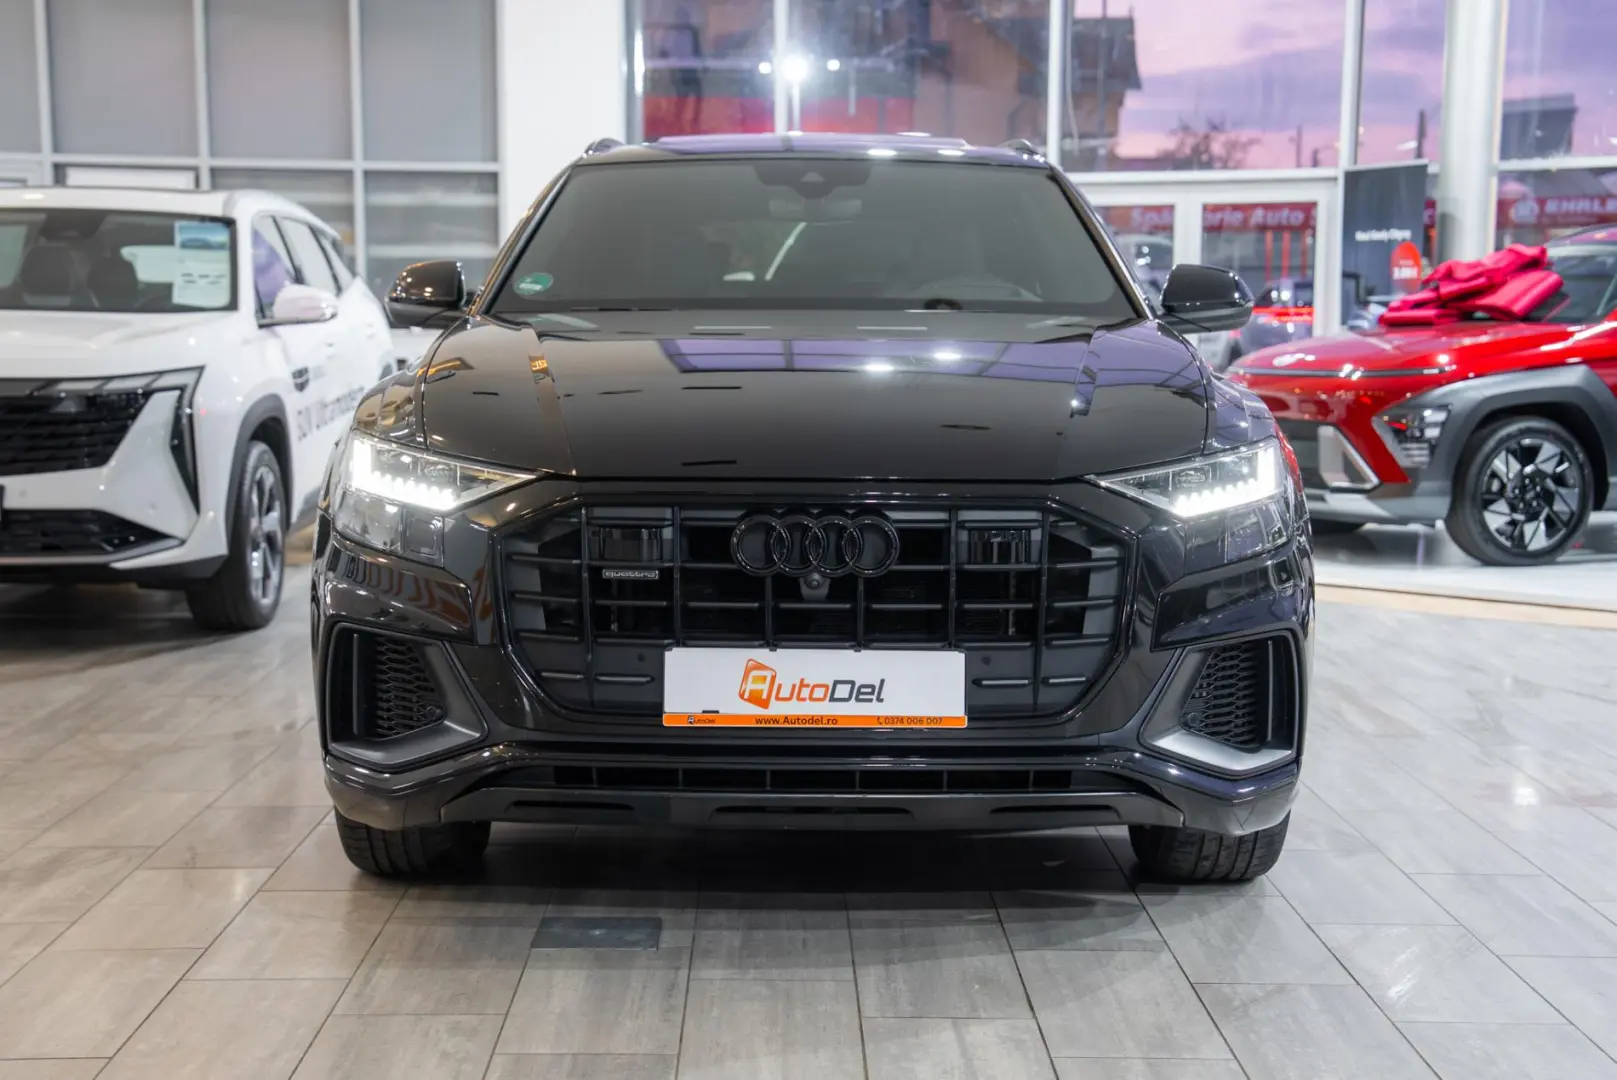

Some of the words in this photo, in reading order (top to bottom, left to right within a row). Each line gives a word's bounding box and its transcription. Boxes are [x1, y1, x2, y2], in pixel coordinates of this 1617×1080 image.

[1250, 206, 1305, 227] Auto
[604, 570, 656, 579] quattro
[739, 659, 886, 708] AutoDel
[755, 715, 838, 726] www.Autodel.ro
[884, 716, 905, 726] 0374
[906, 716, 925, 726] 006
[926, 716, 943, 726] 007
